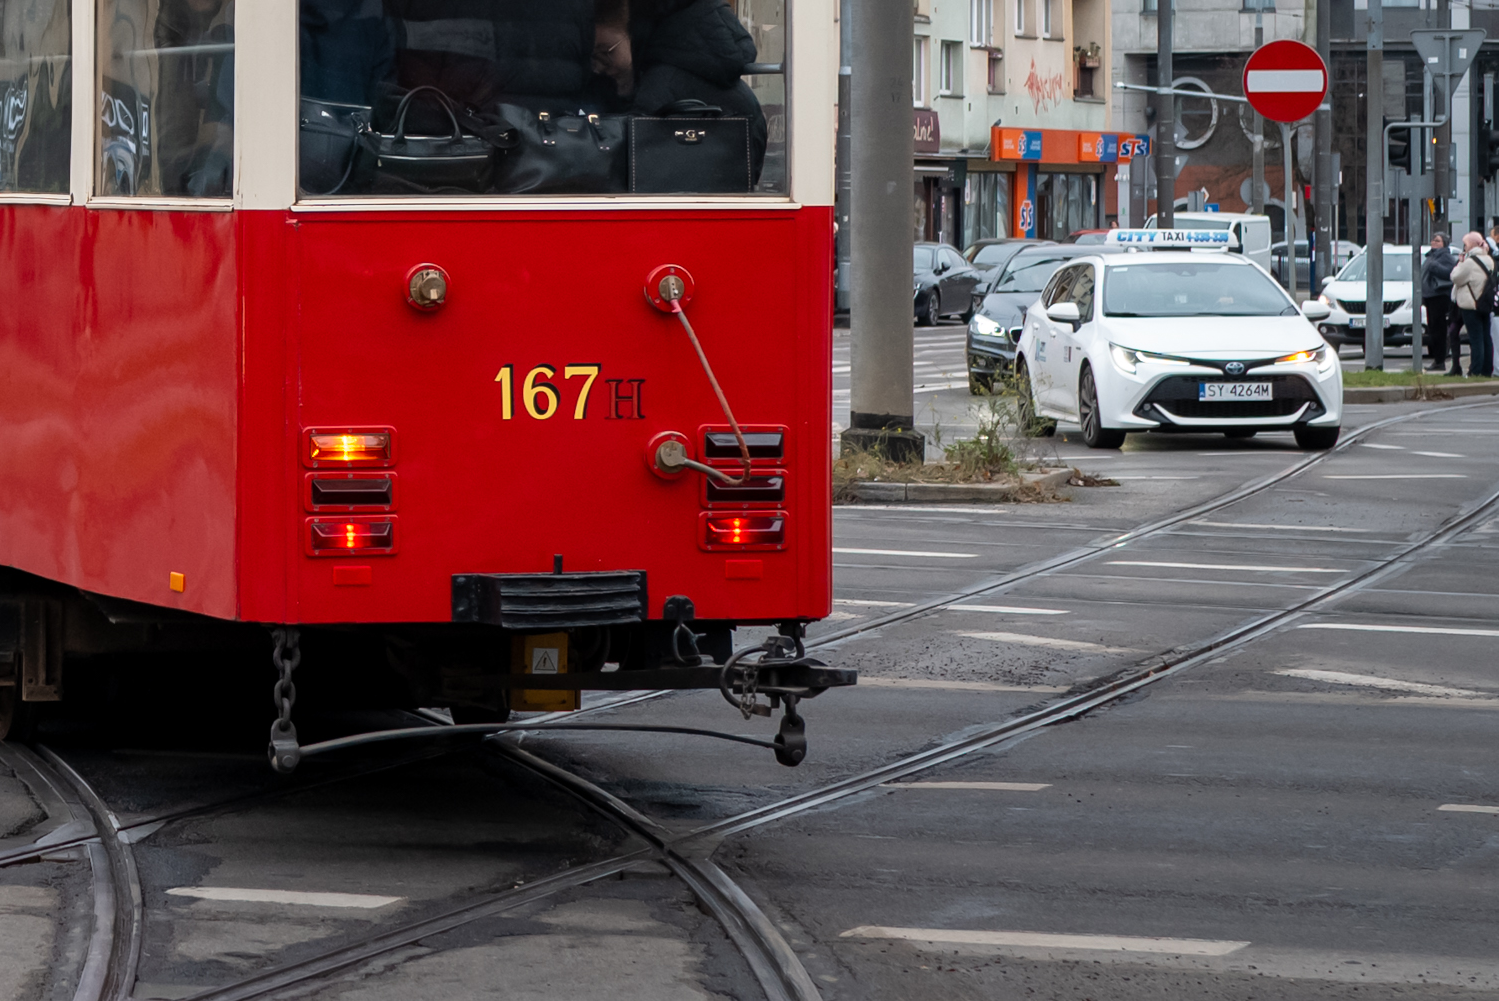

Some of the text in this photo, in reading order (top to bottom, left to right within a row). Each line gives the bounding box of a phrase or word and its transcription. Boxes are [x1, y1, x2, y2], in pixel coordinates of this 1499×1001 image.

[1119, 138, 1148, 157] STS
[1020, 200, 1033, 231] STS
[1117, 231, 1158, 242] CITY
[1161, 232, 1185, 241] TAXI
[494, 363, 645, 420] 167 H
[1208, 384, 1269, 397] SY 4264M
